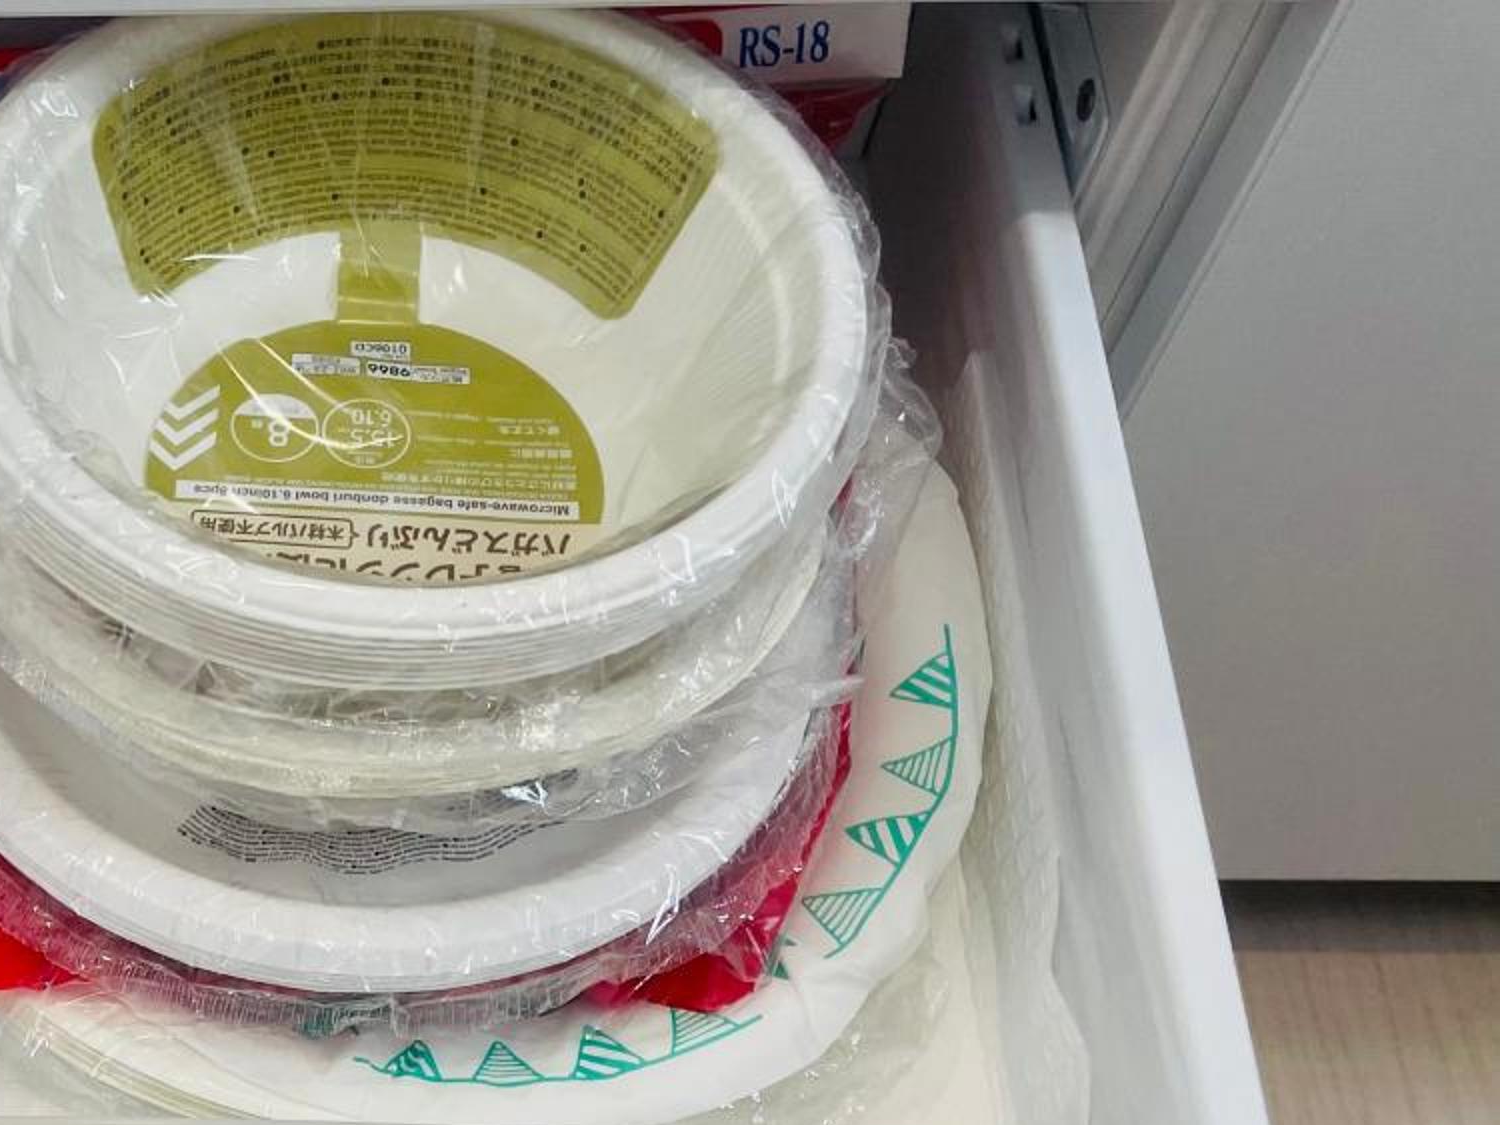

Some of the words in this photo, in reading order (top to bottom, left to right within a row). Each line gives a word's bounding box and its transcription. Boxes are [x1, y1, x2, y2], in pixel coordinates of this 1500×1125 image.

[740, 21, 830, 68] RS-18
[367, 363, 411, 378] 9866
[294, 491, 329, 502] bowl
[332, 493, 389, 506] donburi
[392, 496, 453, 510] bagasse
[457, 499, 570, 516] Microwave-safe
[200, 514, 343, 542] 木材パルプ不使用
[367, 523, 571, 556] バガスどんぶり
